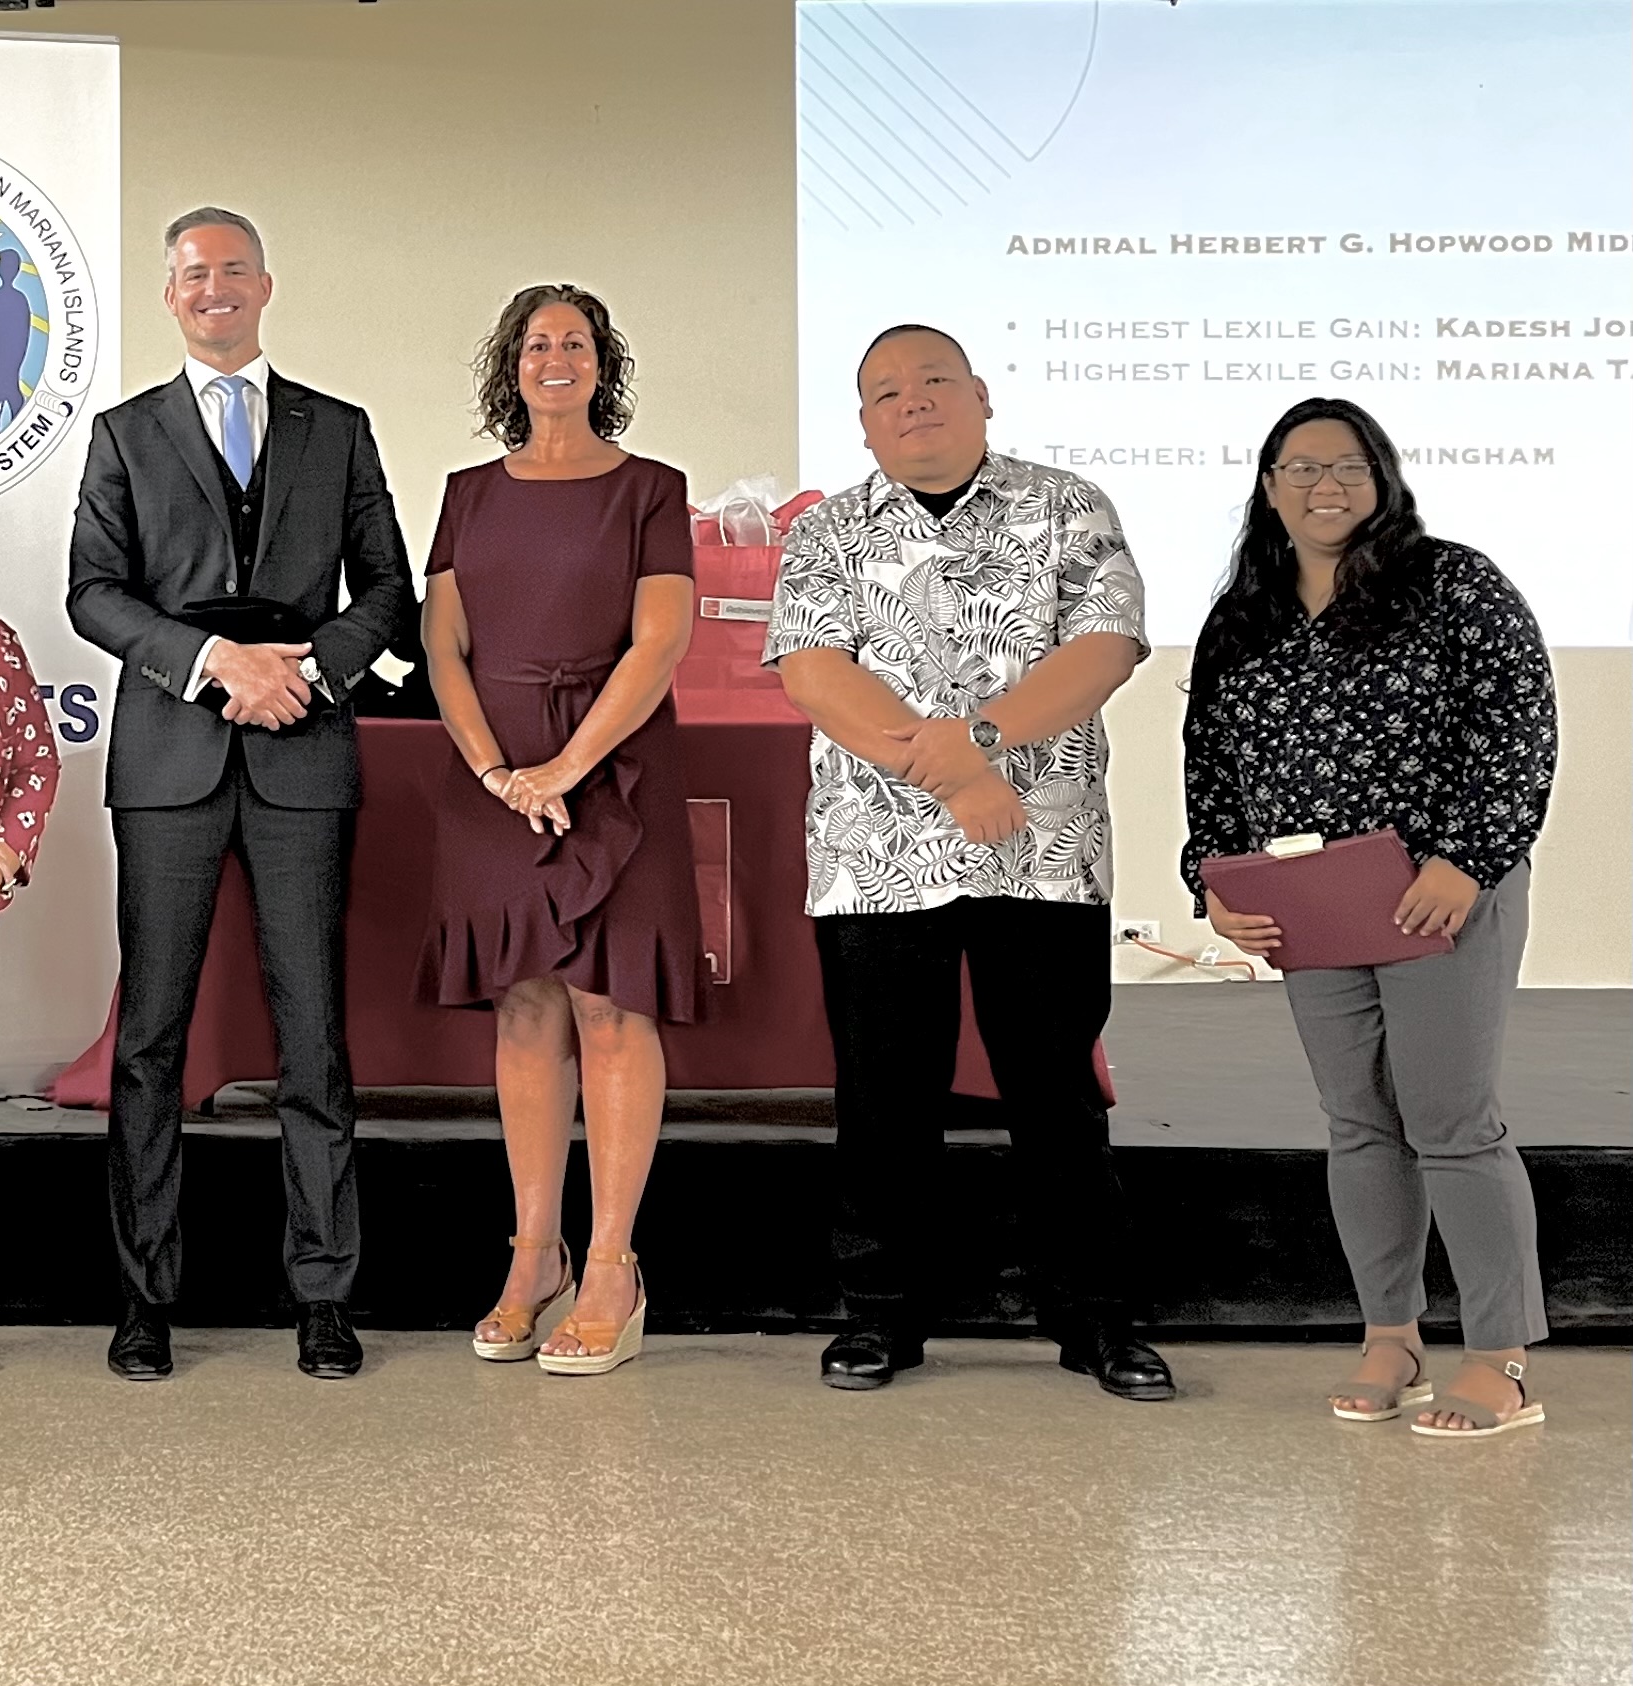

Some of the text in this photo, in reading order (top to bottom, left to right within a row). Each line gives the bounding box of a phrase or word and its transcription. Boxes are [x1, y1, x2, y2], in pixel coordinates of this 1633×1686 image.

[1006, 231, 1633, 255] ADMIRAL HERBERT G. HOPWOOD MID
[9, 191, 76, 286] MARIANA
[59, 287, 85, 384] ISLANDS
[1045, 318, 1190, 339] HIGHEST
[1203, 318, 1316, 339] LEXILE
[1436, 317, 1571, 338] KADESH
[1583, 316, 1633, 337] JO
[1046, 360, 1191, 382] HIGHEST
[1204, 360, 1317, 381] LEXILE
[1436, 360, 1595, 381] MARIANA
